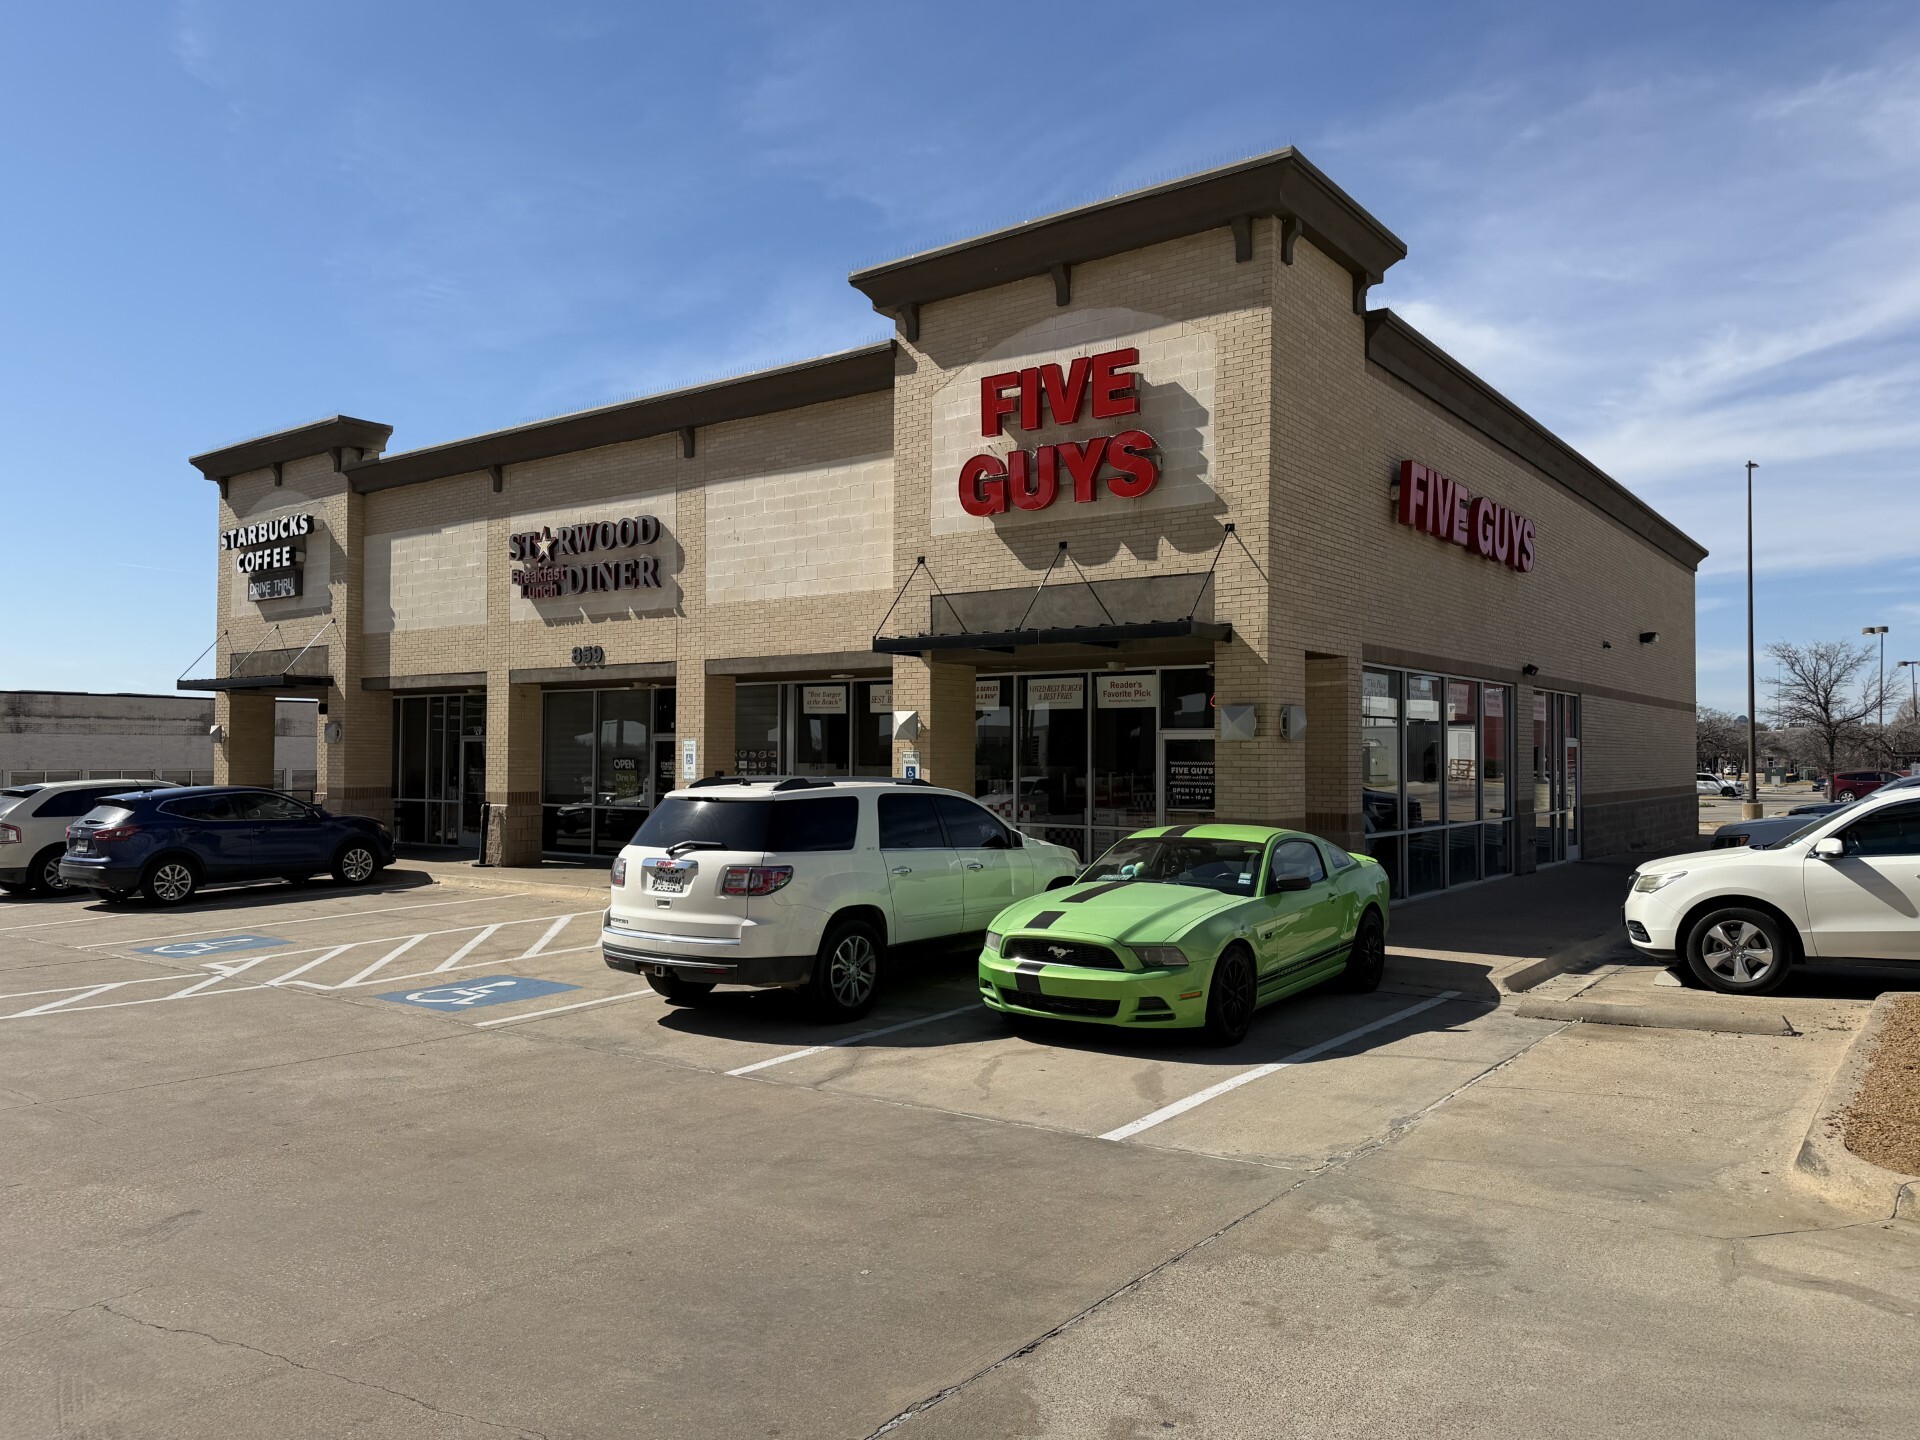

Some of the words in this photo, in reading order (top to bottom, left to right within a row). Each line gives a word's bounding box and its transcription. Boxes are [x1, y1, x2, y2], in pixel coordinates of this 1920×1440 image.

[981, 347, 1140, 438] FIVE
[958, 429, 1160, 517] GUYS
[1398, 460, 1469, 546] FIVE
[1470, 497, 1535, 573] GUYS
[220, 514, 313, 551] STARBUCKS
[236, 546, 294, 573] COFFEE
[512, 566, 566, 584] Breakfast
[564, 556, 661, 595] DINER
[250, 581, 271, 595] DRIVE
[273, 577, 294, 592] THRU
[521, 582, 560, 599] Lunch
[572, 645, 603, 664] 859
[1043, 692, 1056, 700] BEST
[1057, 691, 1073, 700] FRIES
[1047, 684, 1060, 692] BEST
[1103, 690, 1132, 698] Favorite
[1134, 689, 1152, 697] Pick
[871, 695, 886, 703] BEST
[613, 759, 635, 770] OPEN
[615, 773, 629, 782] Dine
[630, 774, 636, 782] In
